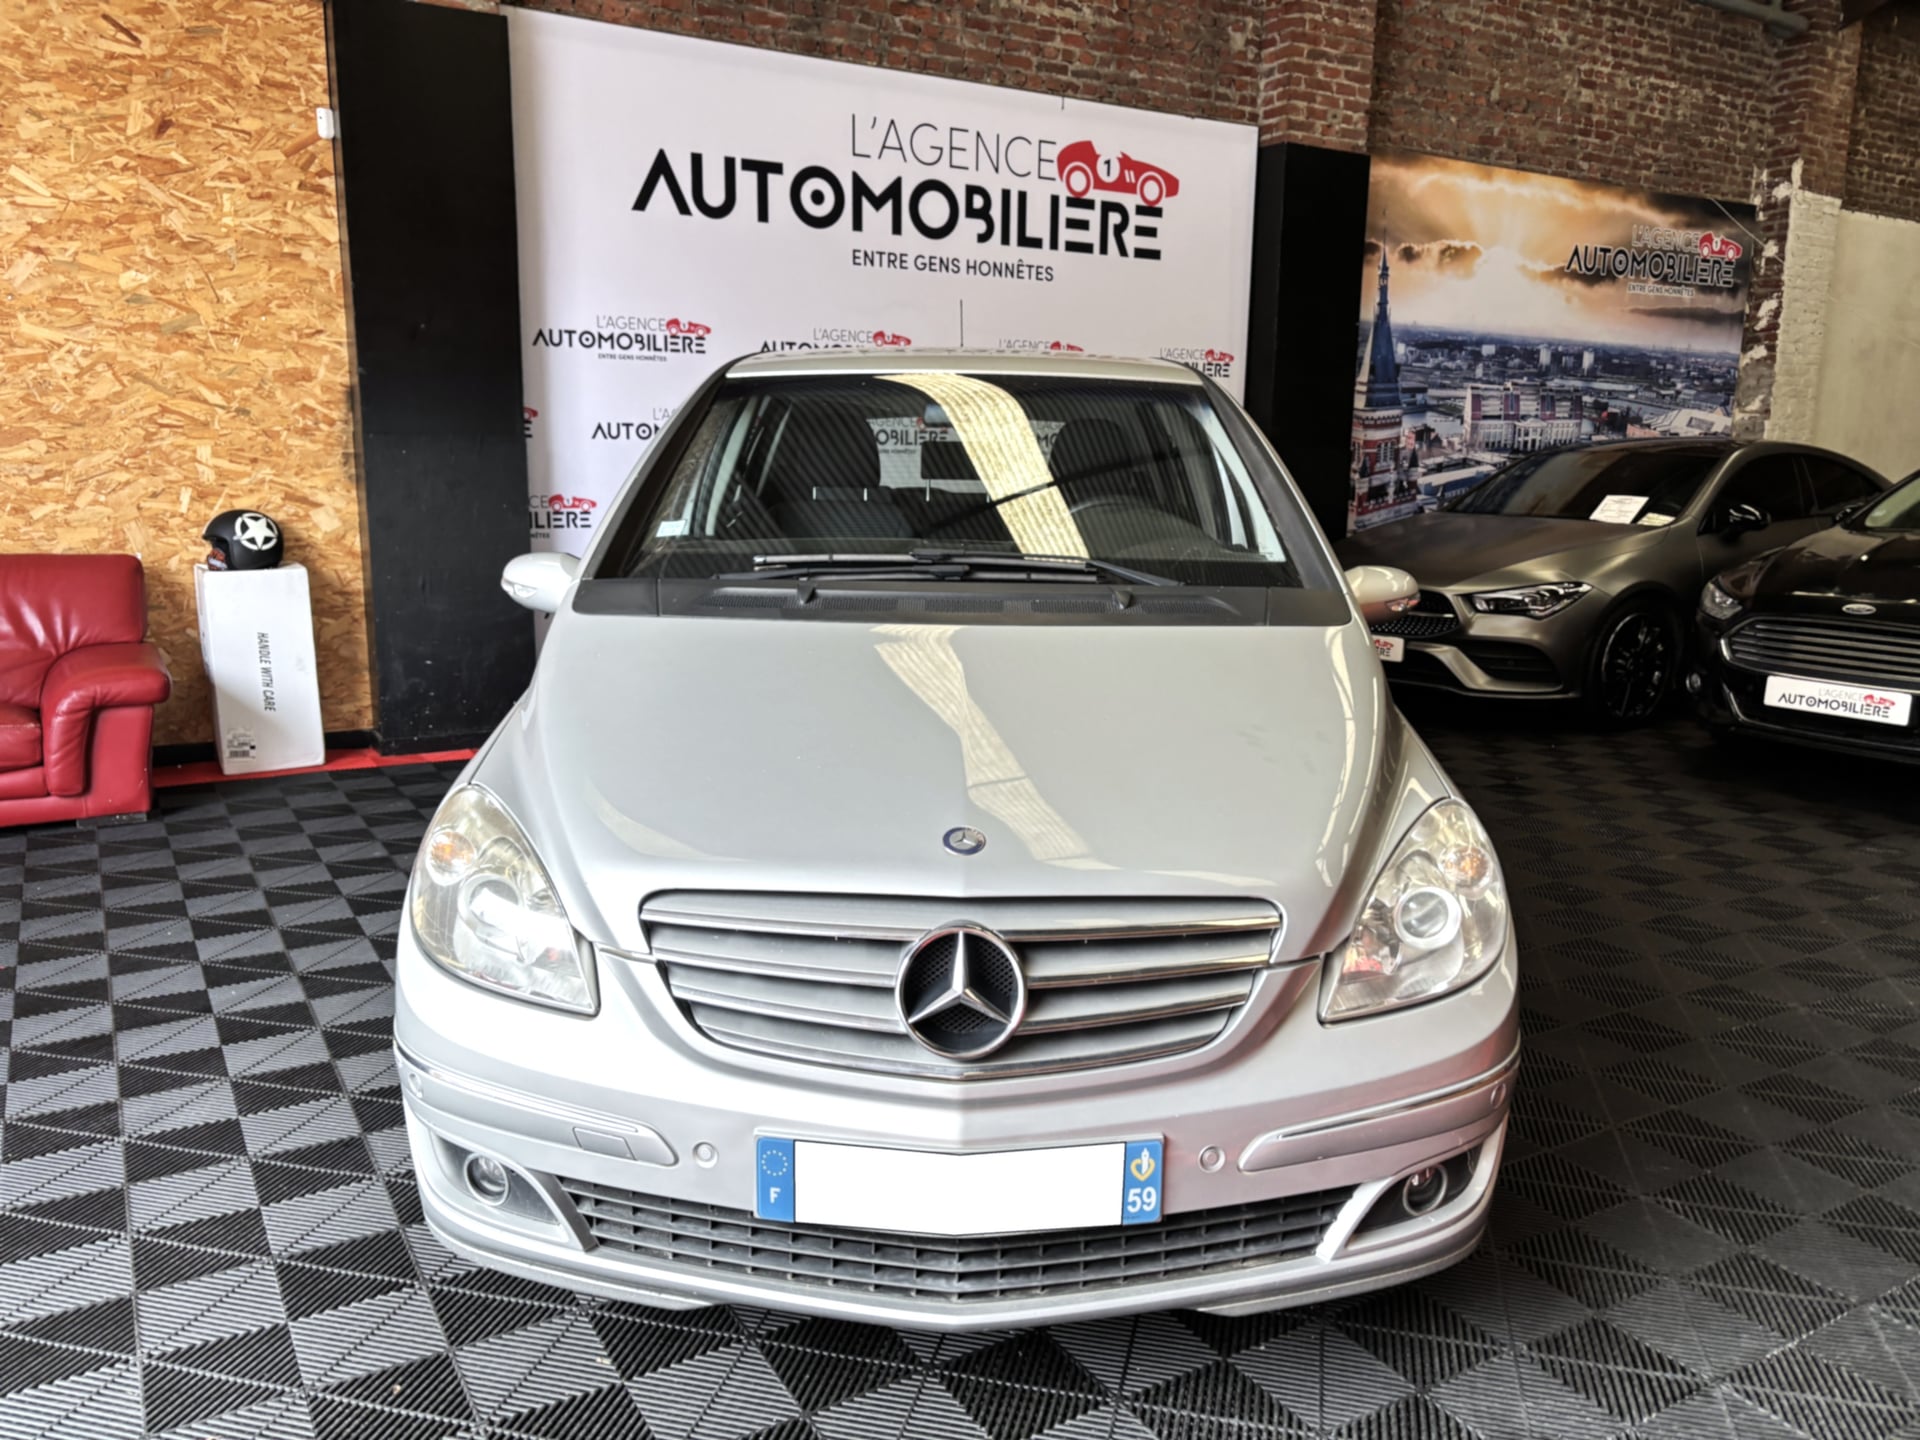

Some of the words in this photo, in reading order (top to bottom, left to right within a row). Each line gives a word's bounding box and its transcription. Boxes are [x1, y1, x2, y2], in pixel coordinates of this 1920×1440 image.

[852, 113, 1057, 181] L'AGENCE
[1103, 158, 1112, 177] 1
[1631, 224, 1700, 253] L'AGENCE
[852, 249, 908, 270] ENTRE
[914, 254, 960, 275] GENS
[966, 259, 1054, 282] HONNÊTES
[1627, 283, 1646, 294] ENTRE
[1648, 285, 1663, 295] GENS
[596, 315, 666, 332] L'AGENCE
[812, 328, 873, 344] L'AGENCE
[1160, 347, 1205, 360] L'AGENCE
[257, 632, 272, 664] HANDLE
[260, 667, 273, 688] WITH
[263, 690, 276, 711] CARE
[770, 1186, 781, 1204] F
[1127, 1186, 1157, 1213] 59
